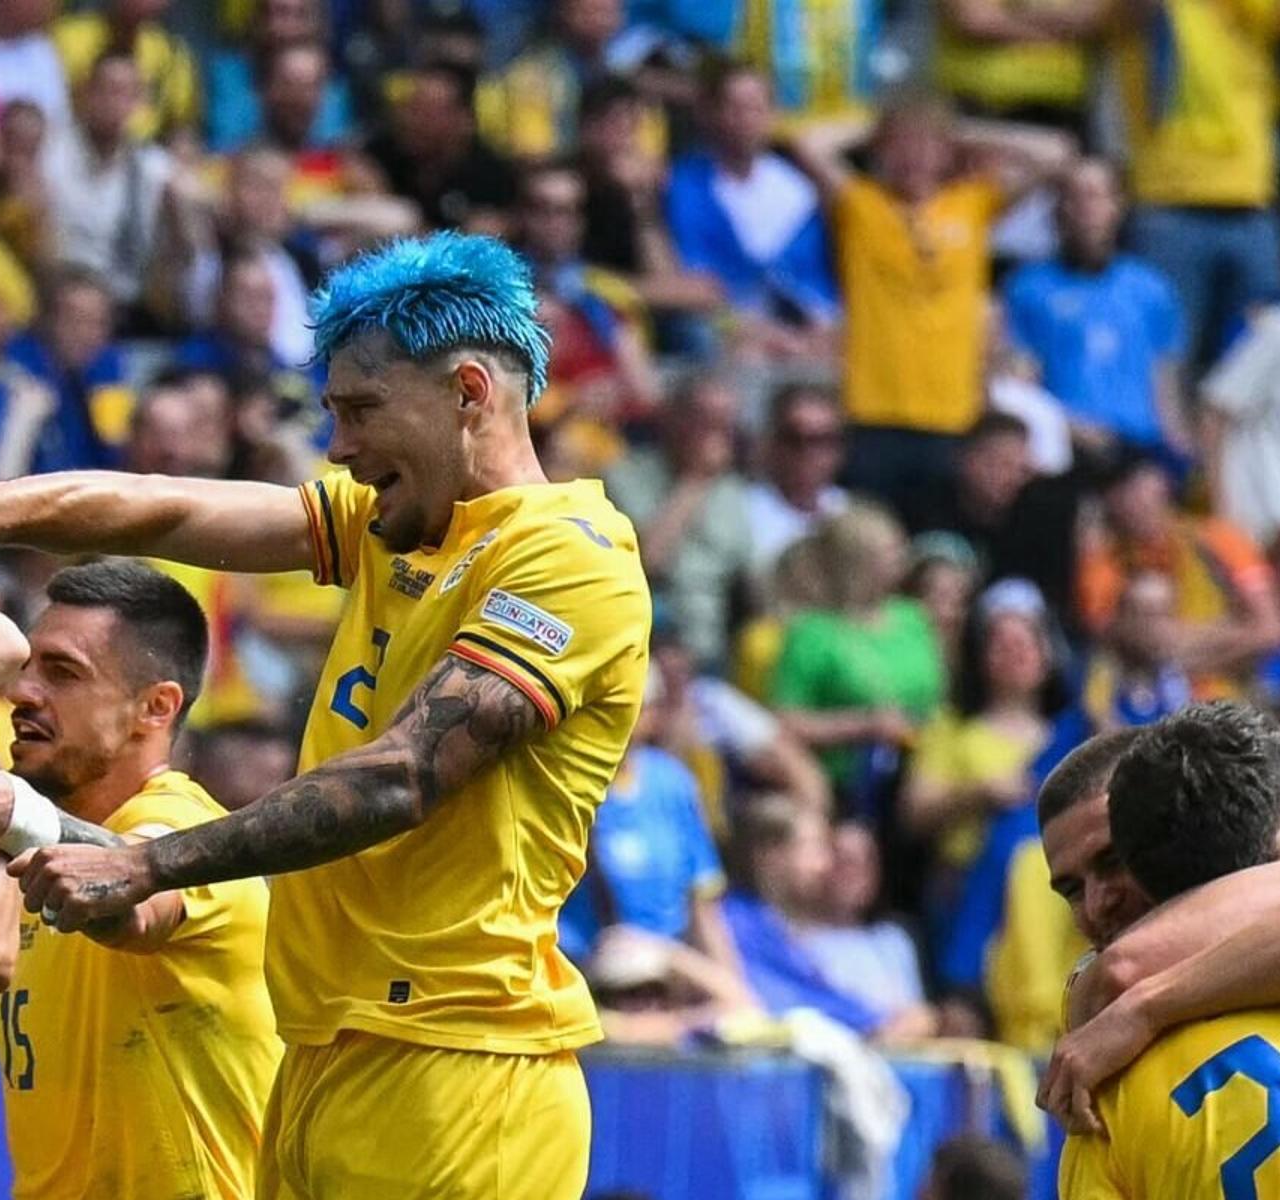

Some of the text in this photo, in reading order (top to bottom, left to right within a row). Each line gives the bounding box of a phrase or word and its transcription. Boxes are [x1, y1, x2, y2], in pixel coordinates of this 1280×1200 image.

[485, 597, 568, 647] FOUNDATION
[329, 626, 392, 731] 2
[0, 988, 35, 1090] 15
